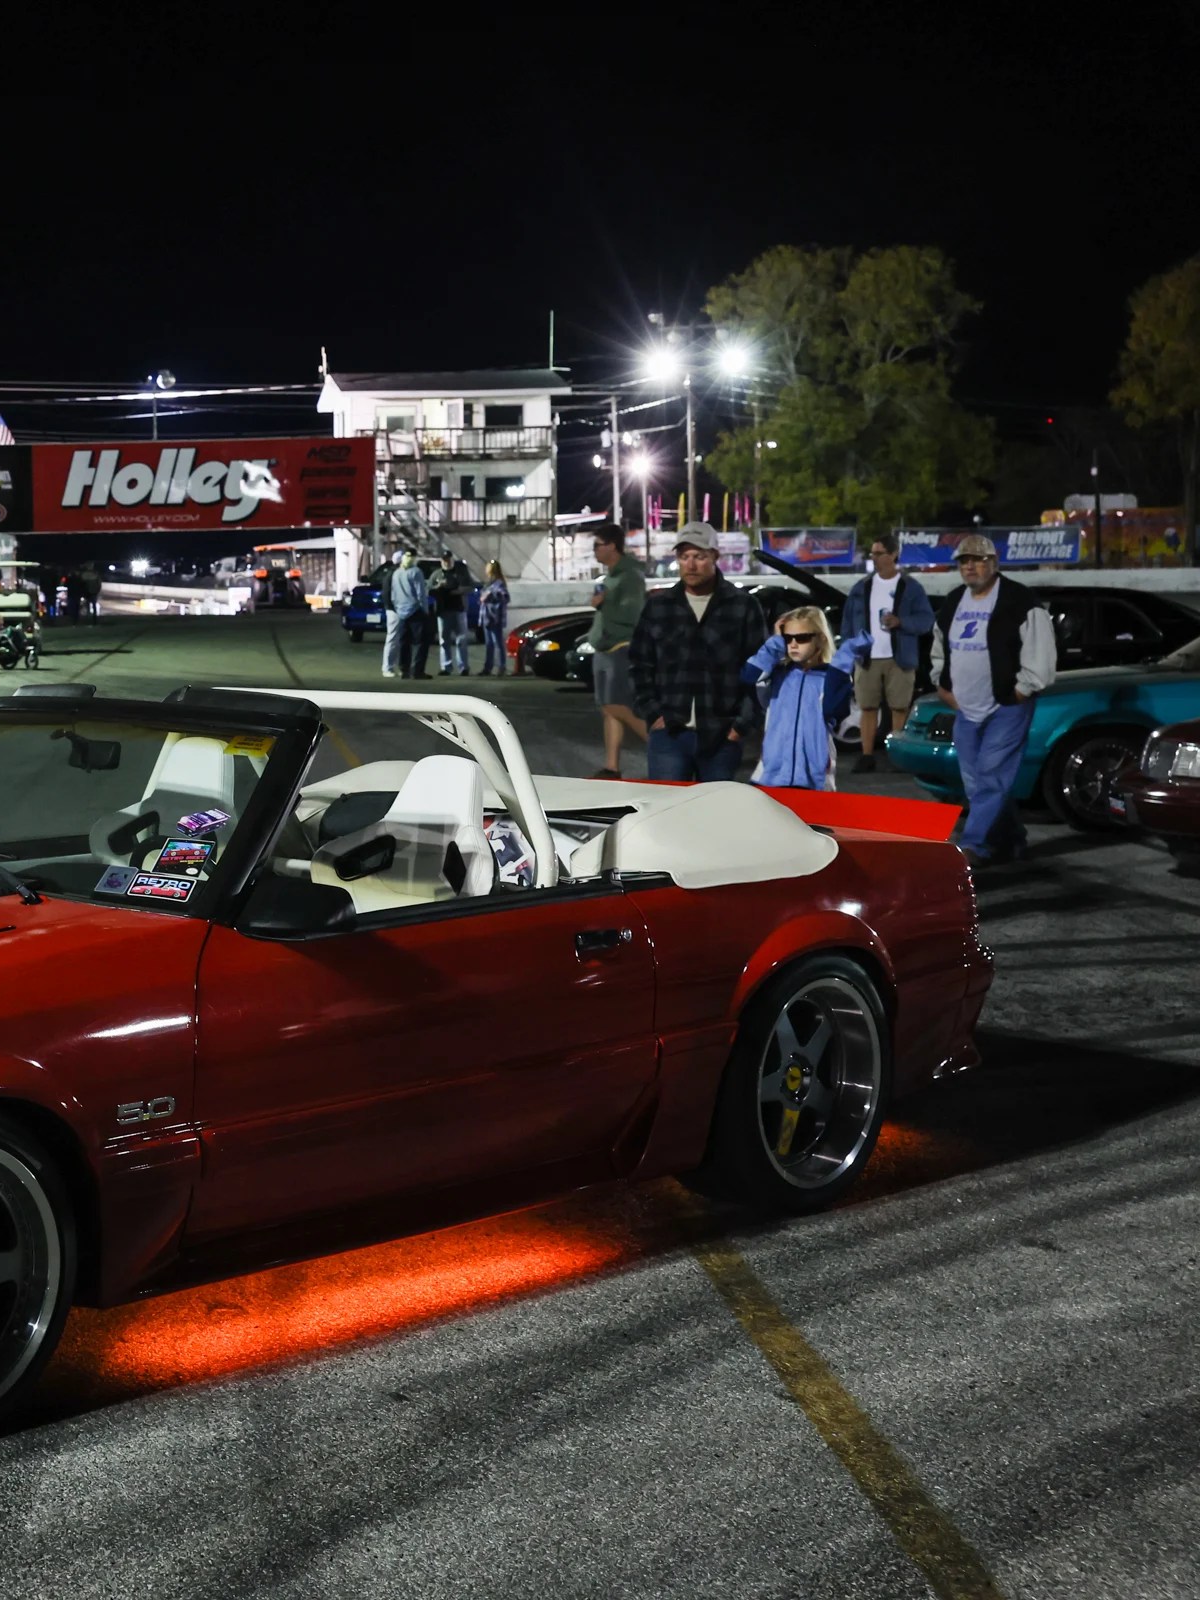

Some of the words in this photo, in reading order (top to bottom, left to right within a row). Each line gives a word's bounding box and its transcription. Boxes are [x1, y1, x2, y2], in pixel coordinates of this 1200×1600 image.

[61, 448, 269, 522] Holley
[899, 531, 939, 548] Holley
[1008, 531, 1065, 546] BURNOUT
[1007, 545, 1073, 560] CHALLENGE
[136, 877, 191, 890] RETRO
[117, 1096, 176, 1125] 5.0
